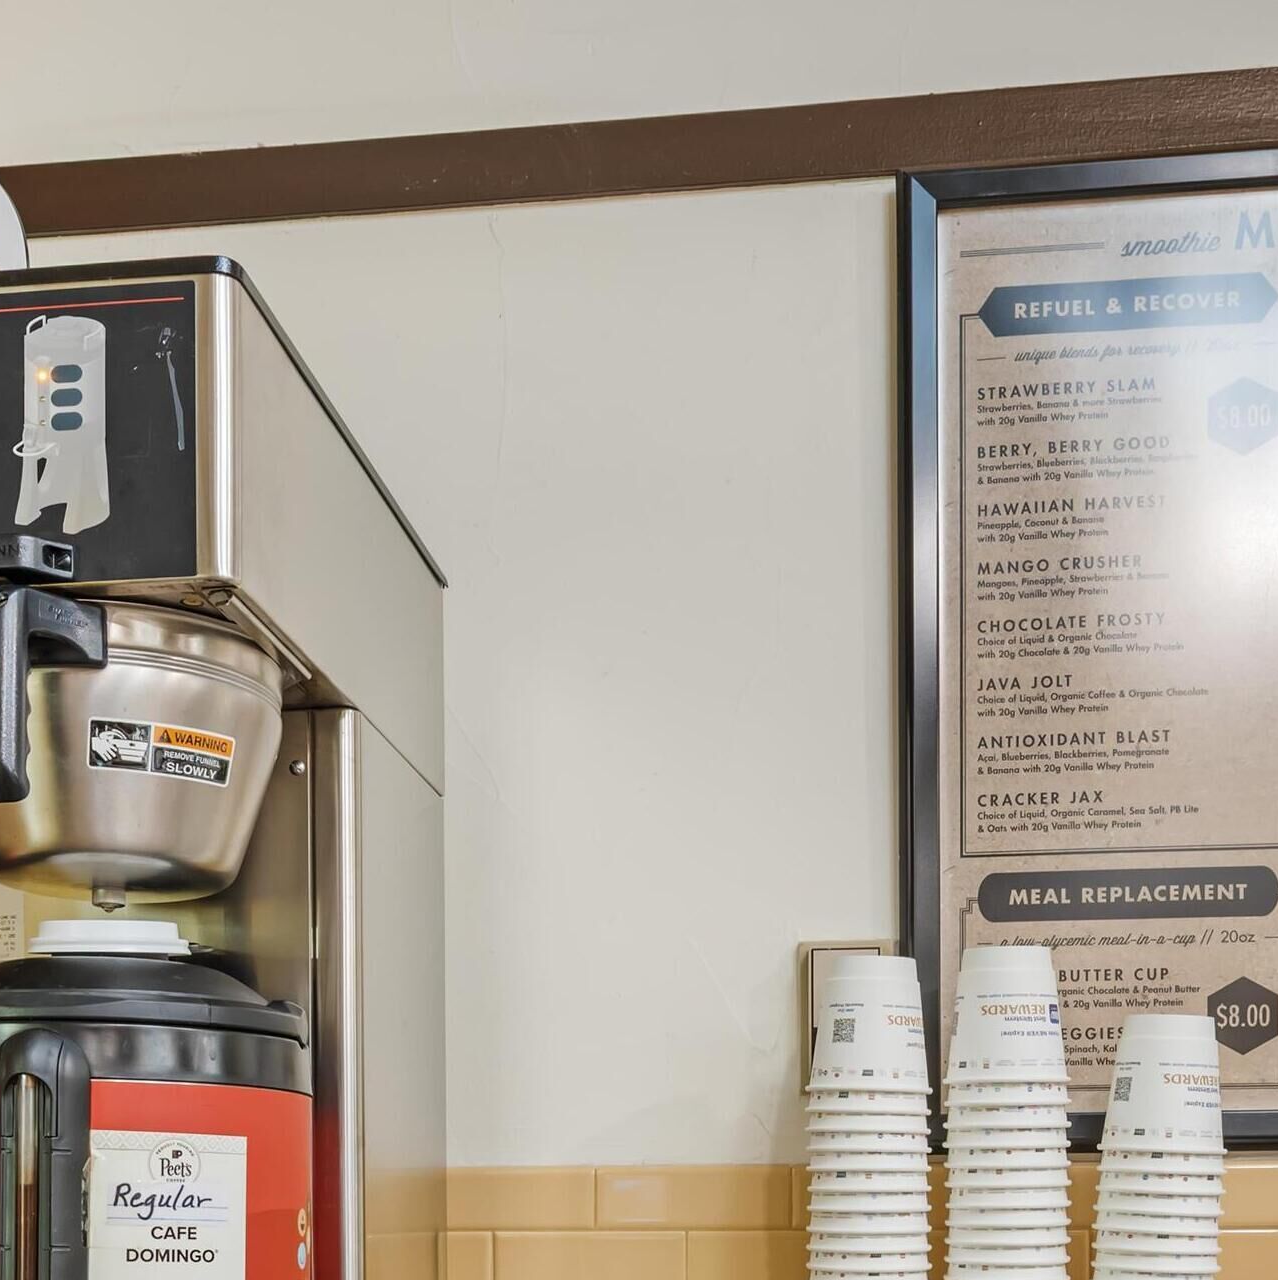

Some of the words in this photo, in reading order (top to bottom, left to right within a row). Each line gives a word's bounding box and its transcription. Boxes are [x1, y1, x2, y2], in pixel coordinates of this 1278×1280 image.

[1120, 231, 1222, 258] smoothie
[1014, 301, 1096, 320] REFUEL
[1106, 297, 1123, 315] &
[1134, 291, 1241, 313] RECOVER
[1014, 347, 1057, 364] unique
[977, 381, 1096, 401] STRAWBERRY
[1106, 378, 1157, 393] SLAM
[977, 443, 1038, 459] BERRY,
[1048, 439, 1103, 454] BERRY
[1113, 436, 1170, 451] GOOD
[977, 499, 1075, 517] HAWAIIAN
[1084, 495, 1167, 511] HARVEST
[977, 559, 1050, 576] MANGO
[1059, 555, 1142, 571] CRUSHER
[977, 615, 1087, 634] CHOCOLATE
[1097, 612, 1166, 628] FROSTY
[977, 678, 1022, 691] JAVA
[1031, 674, 1073, 689] JOLT
[174, 732, 228, 753] WARNING
[977, 731, 1107, 750] ANTIOXIDANT
[1116, 729, 1171, 744] BLAST
[163, 750, 195, 763] REMOVE
[1001, 750, 1052, 762] Blueberries,
[1054, 748, 1110, 760] Blackberries,
[1112, 747, 1170, 759] Pomegranate
[166, 761, 218, 780] SLOWLY
[977, 792, 1060, 807] CRACKER
[1070, 790, 1104, 804] JAX
[1009, 887, 1071, 906] MEAL
[1082, 883, 1249, 904] REPLACEMENT
[1098, 932, 1197, 949] meal-in-a-cup
[1220, 930, 1256, 943] 20oz
[1059, 968, 1124, 982] BUTTER
[1134, 967, 1170, 982] CUP
[981, 1003, 1047, 1017] REWARDS
[1216, 1003, 1271, 1029] $8.00
[1062, 1027, 1124, 1041] EGGIES
[113, 1183, 213, 1221] Regular
[151, 1226, 198, 1241] CAFE
[126, 1248, 215, 1263] DOMINGO
